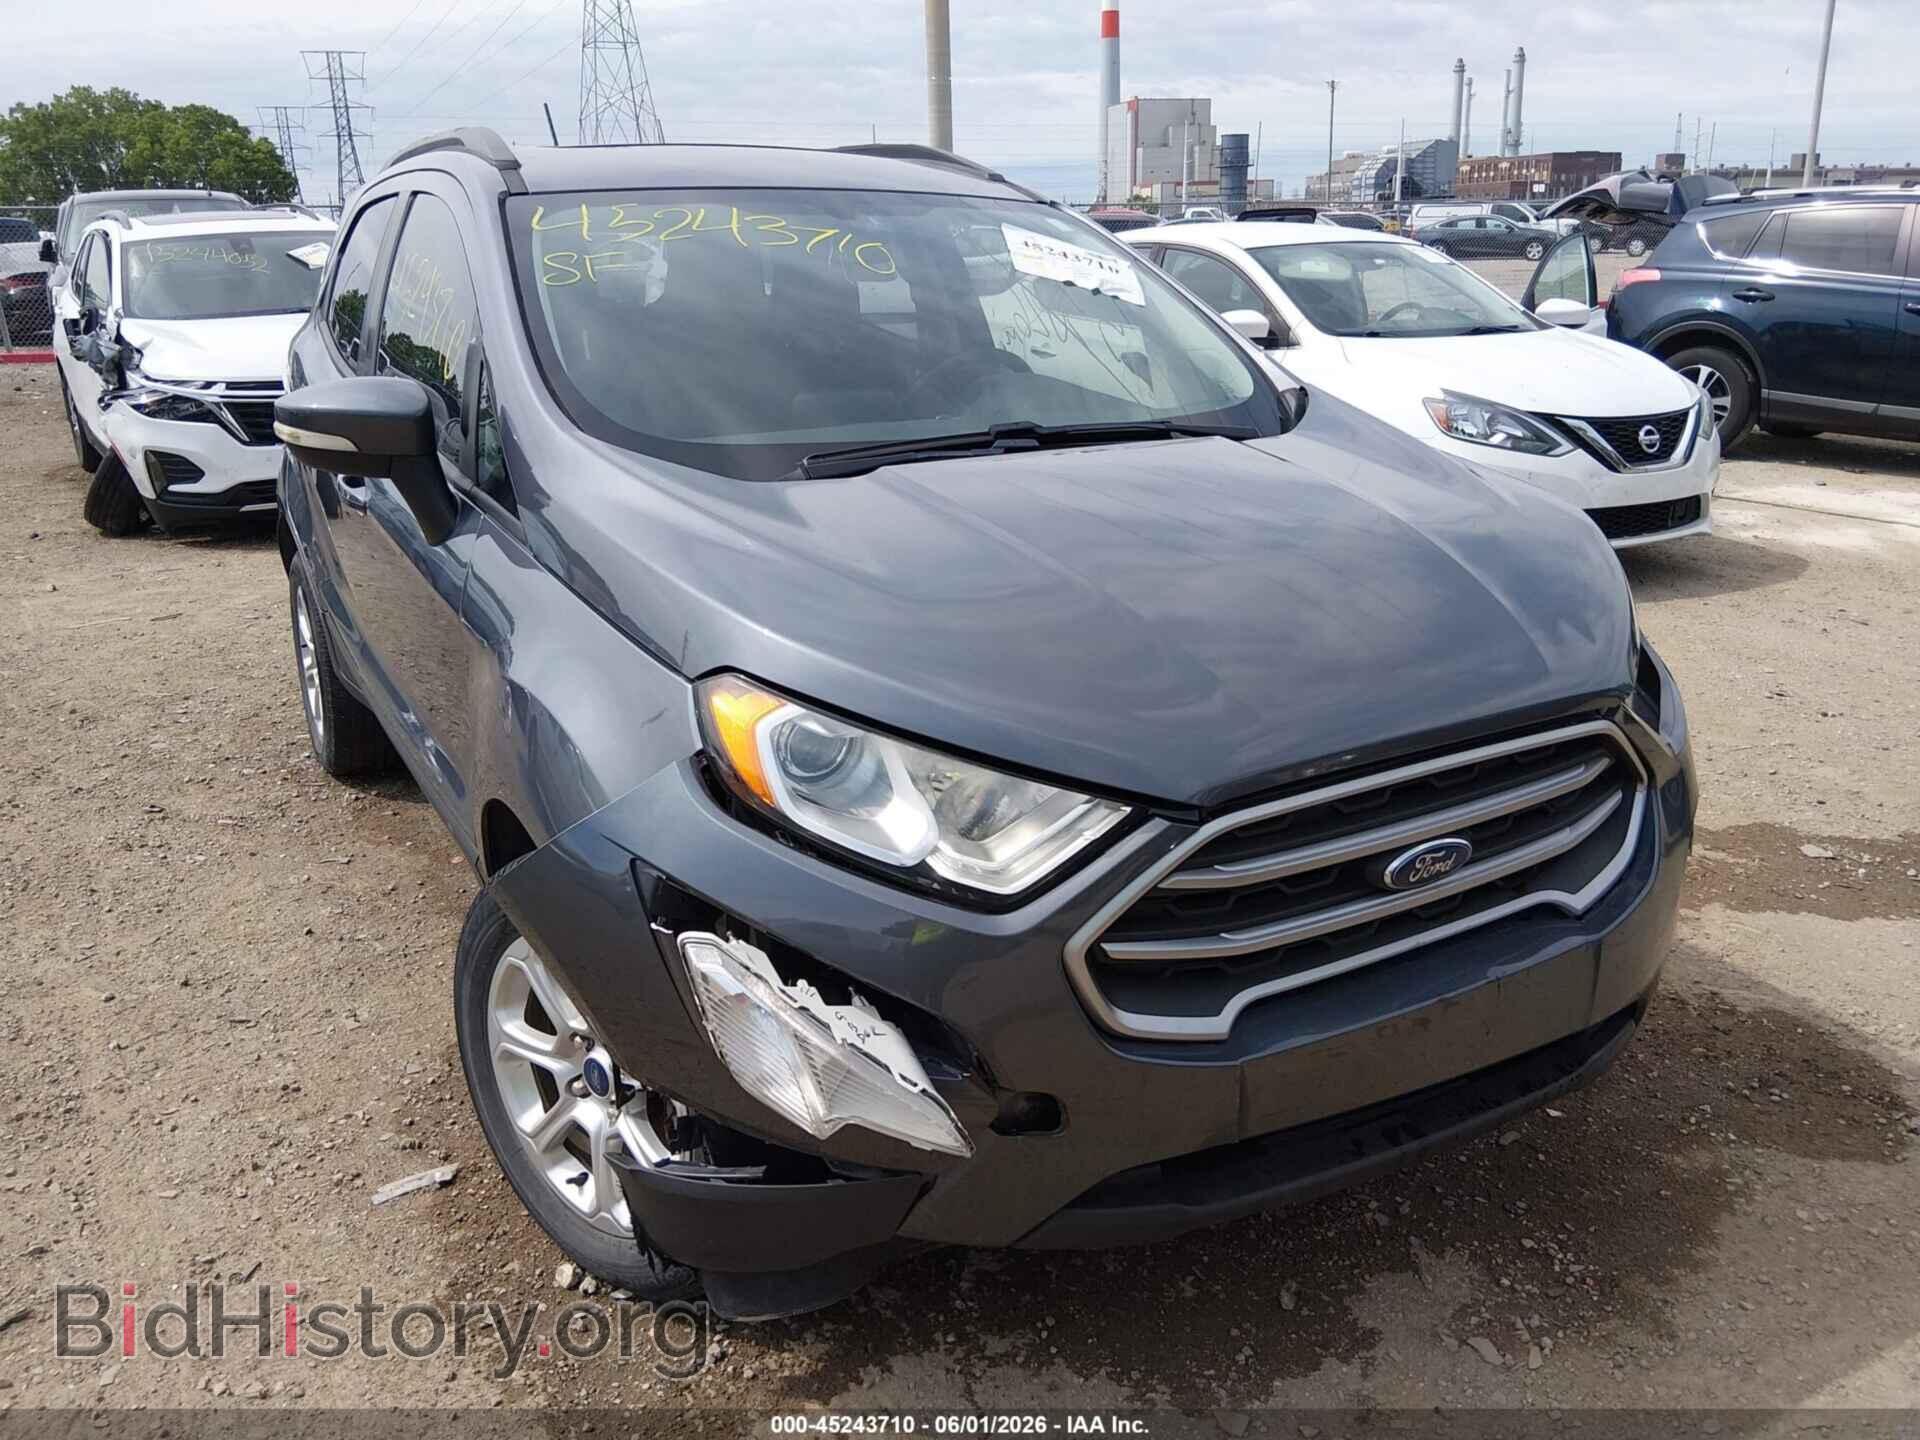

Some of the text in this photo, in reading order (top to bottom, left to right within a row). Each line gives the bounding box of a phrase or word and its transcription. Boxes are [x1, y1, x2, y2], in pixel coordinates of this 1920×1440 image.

[532, 203, 896, 274] 45243710
[543, 251, 650, 286] SF
[1409, 850, 1457, 882] Ford
